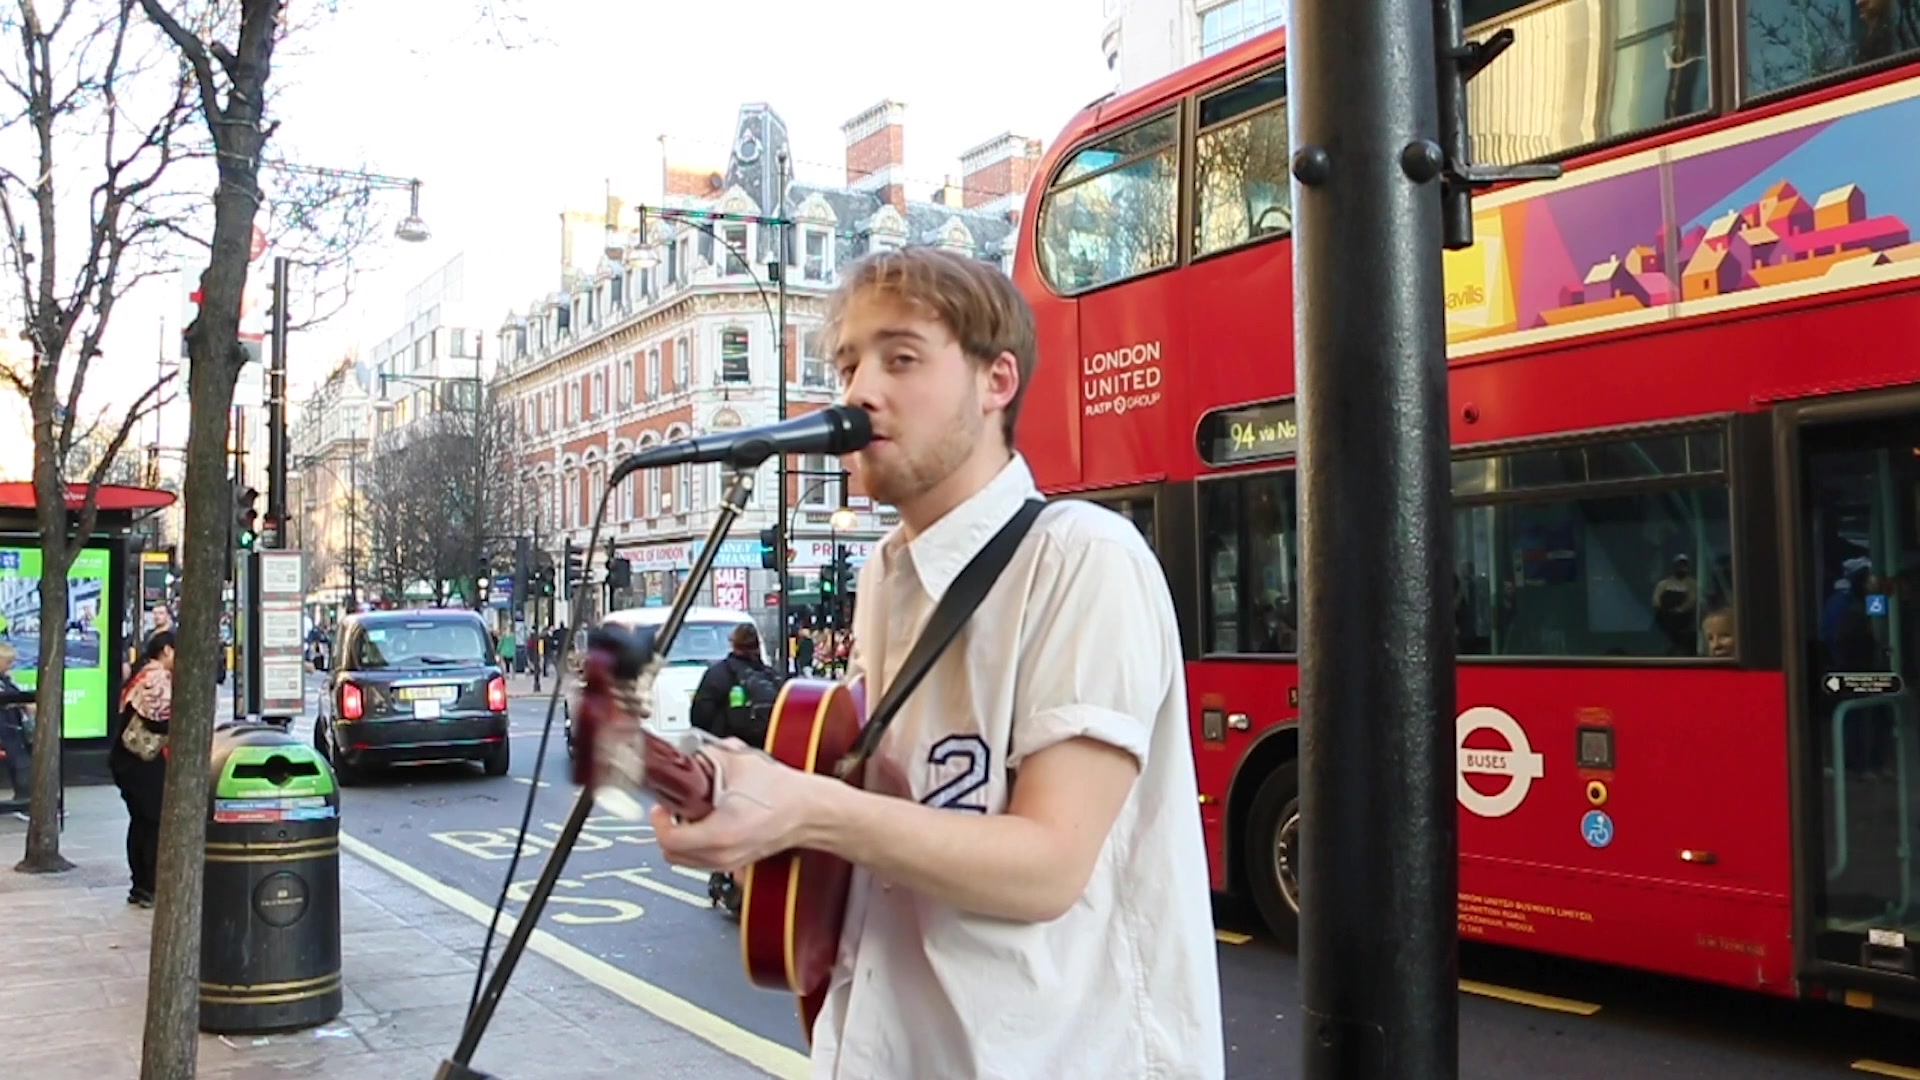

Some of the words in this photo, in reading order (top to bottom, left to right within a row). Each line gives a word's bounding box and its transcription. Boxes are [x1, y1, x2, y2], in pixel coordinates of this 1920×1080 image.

[1444, 285, 1484, 309] avills
[1084, 341, 1161, 375] LONDON
[1084, 367, 1161, 399] UNITED
[1085, 401, 1112, 416] RATP
[1127, 392, 1161, 409] GROUP
[1230, 422, 1256, 452] 94
[1259, 425, 1275, 442] via
[812, 542, 867, 556] PRCE
[715, 568, 746, 583] SALE
[920, 734, 991, 813] 2
[1467, 754, 1507, 769] BUSES
[429, 816, 658, 860] BUS
[505, 866, 712, 925] ST
